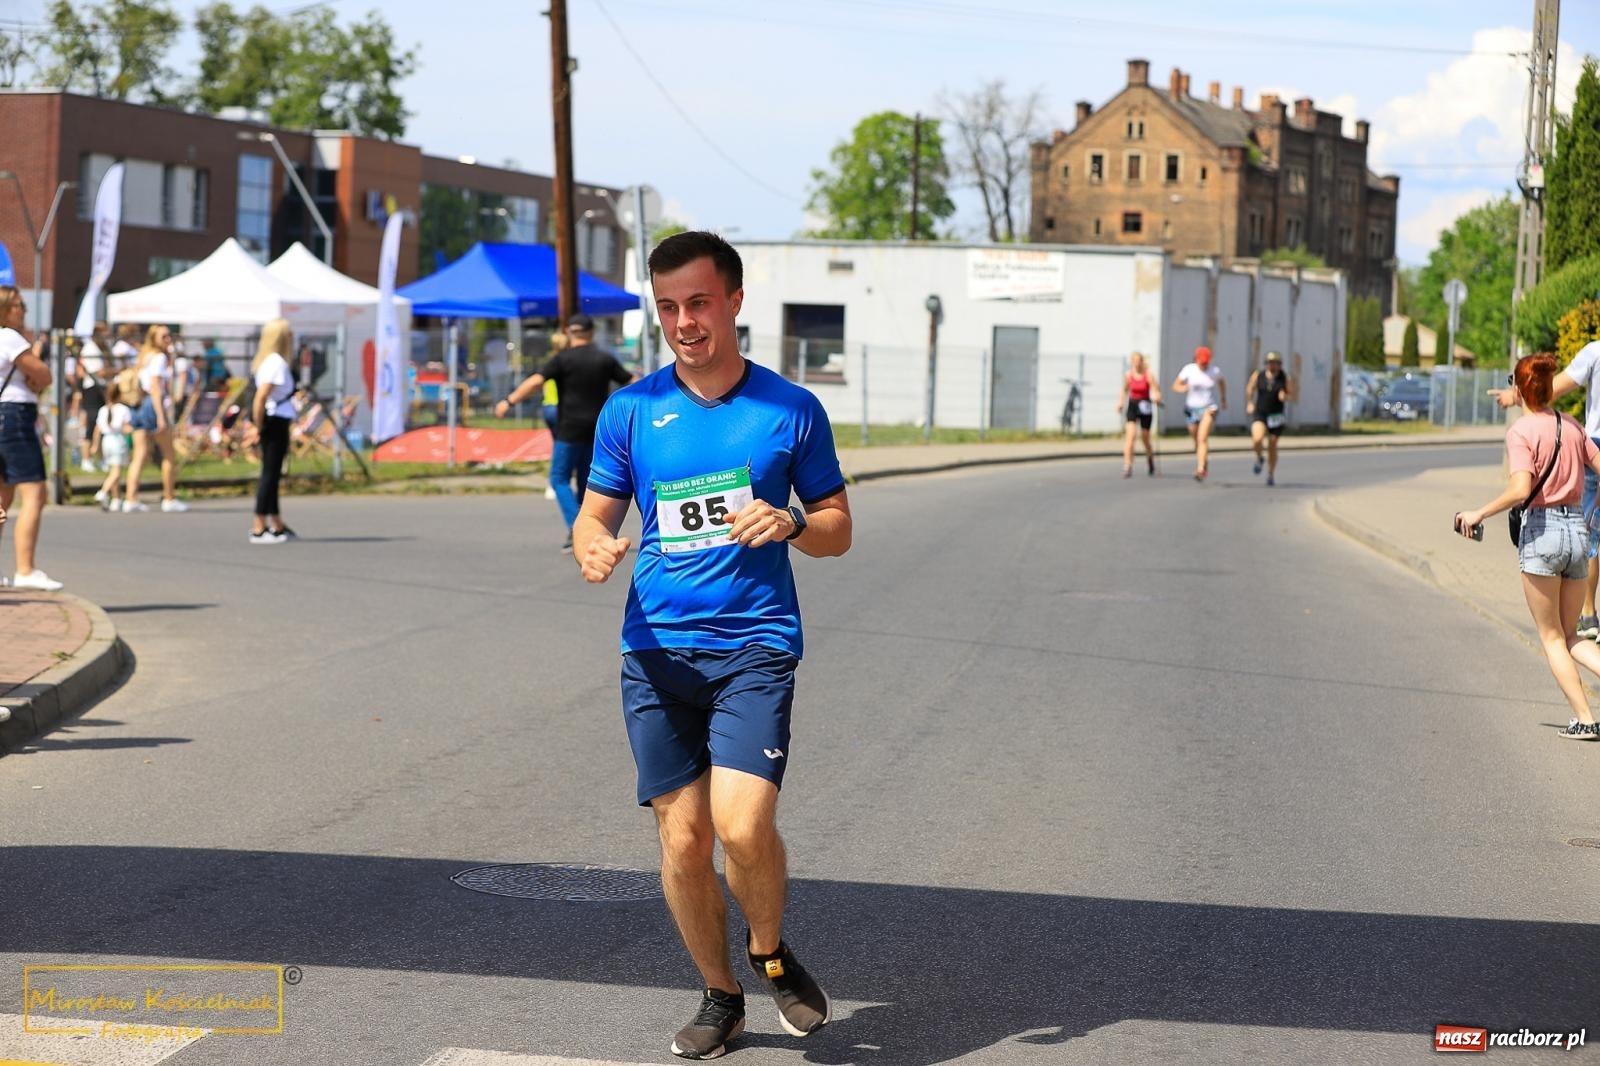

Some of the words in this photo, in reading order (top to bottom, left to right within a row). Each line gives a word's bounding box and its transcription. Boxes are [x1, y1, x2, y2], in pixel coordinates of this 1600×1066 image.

[672, 481, 690, 490] BIEG
[691, 477, 705, 486] BEZ
[706, 472, 737, 483] GRANIC
[680, 496, 729, 531] 85
